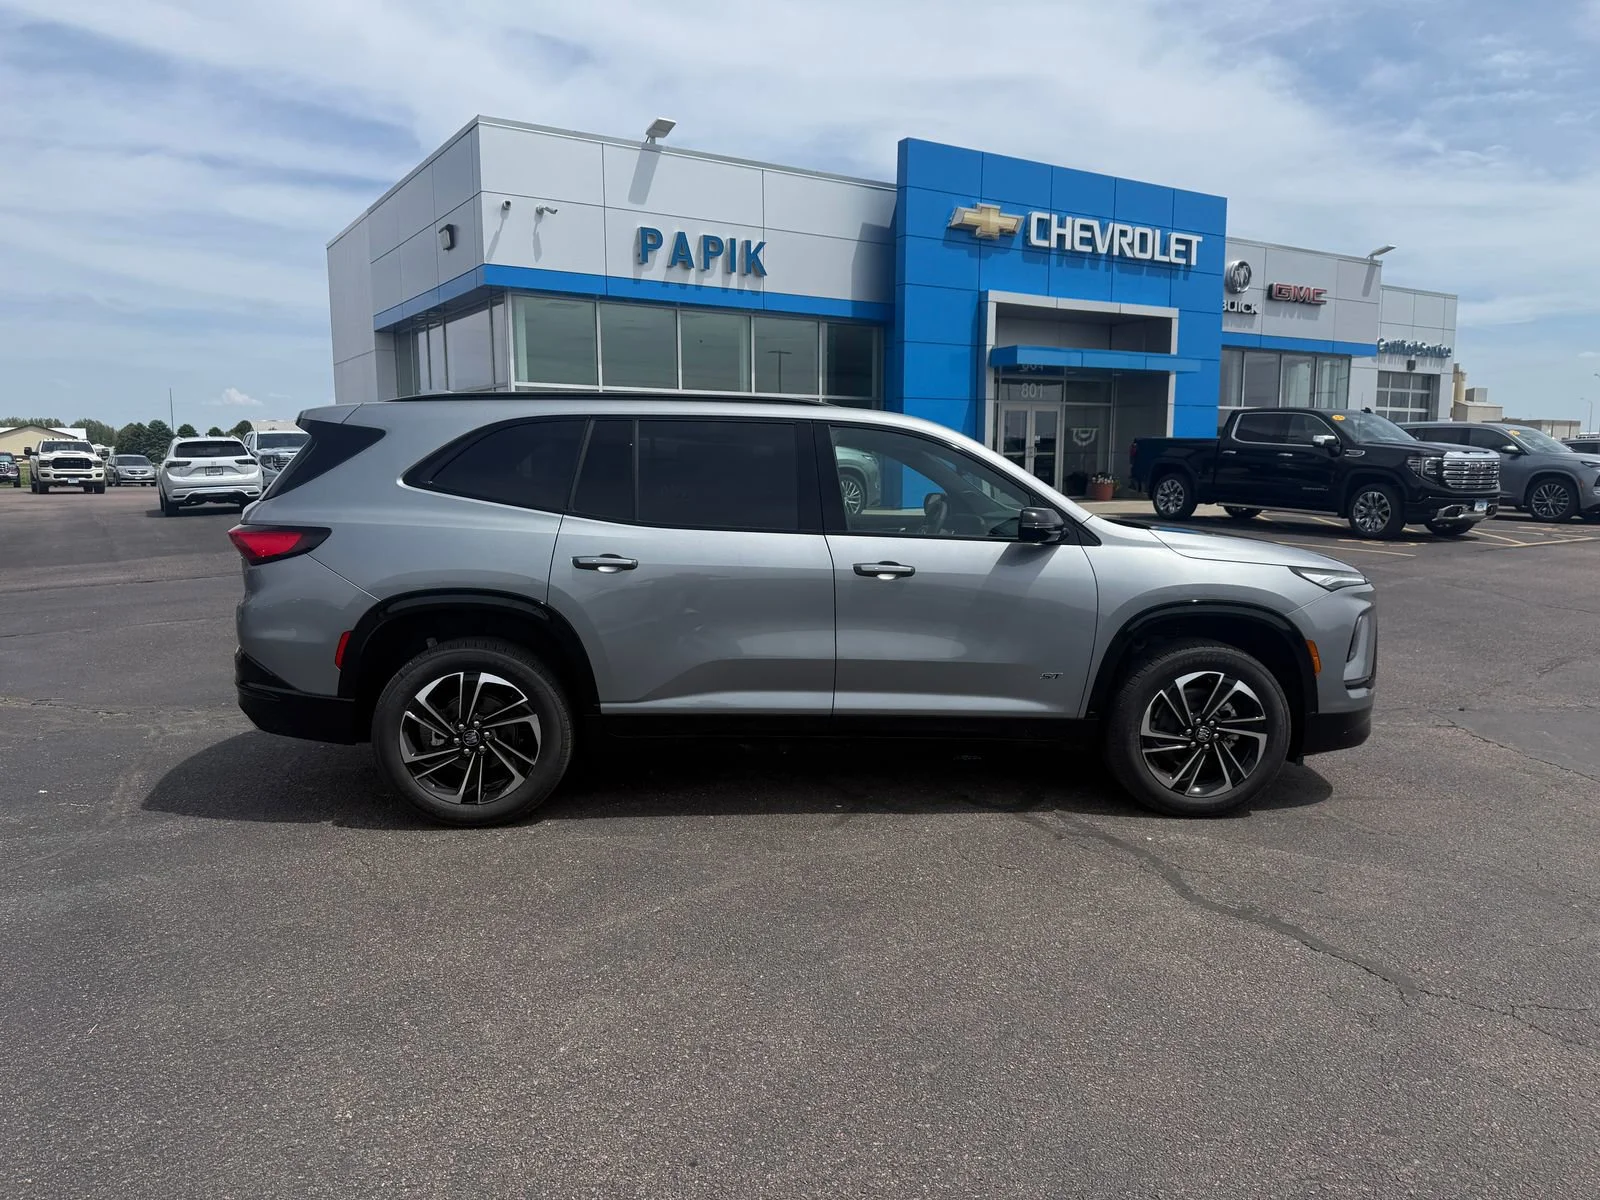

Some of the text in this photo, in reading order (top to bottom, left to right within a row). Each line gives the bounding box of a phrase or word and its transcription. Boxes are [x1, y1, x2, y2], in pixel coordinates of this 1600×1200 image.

[638, 226, 768, 277] PAPIK
[1028, 211, 1203, 266] CHEVROLET
[1271, 282, 1327, 305] GMC
[1021, 383, 1043, 398] 801
